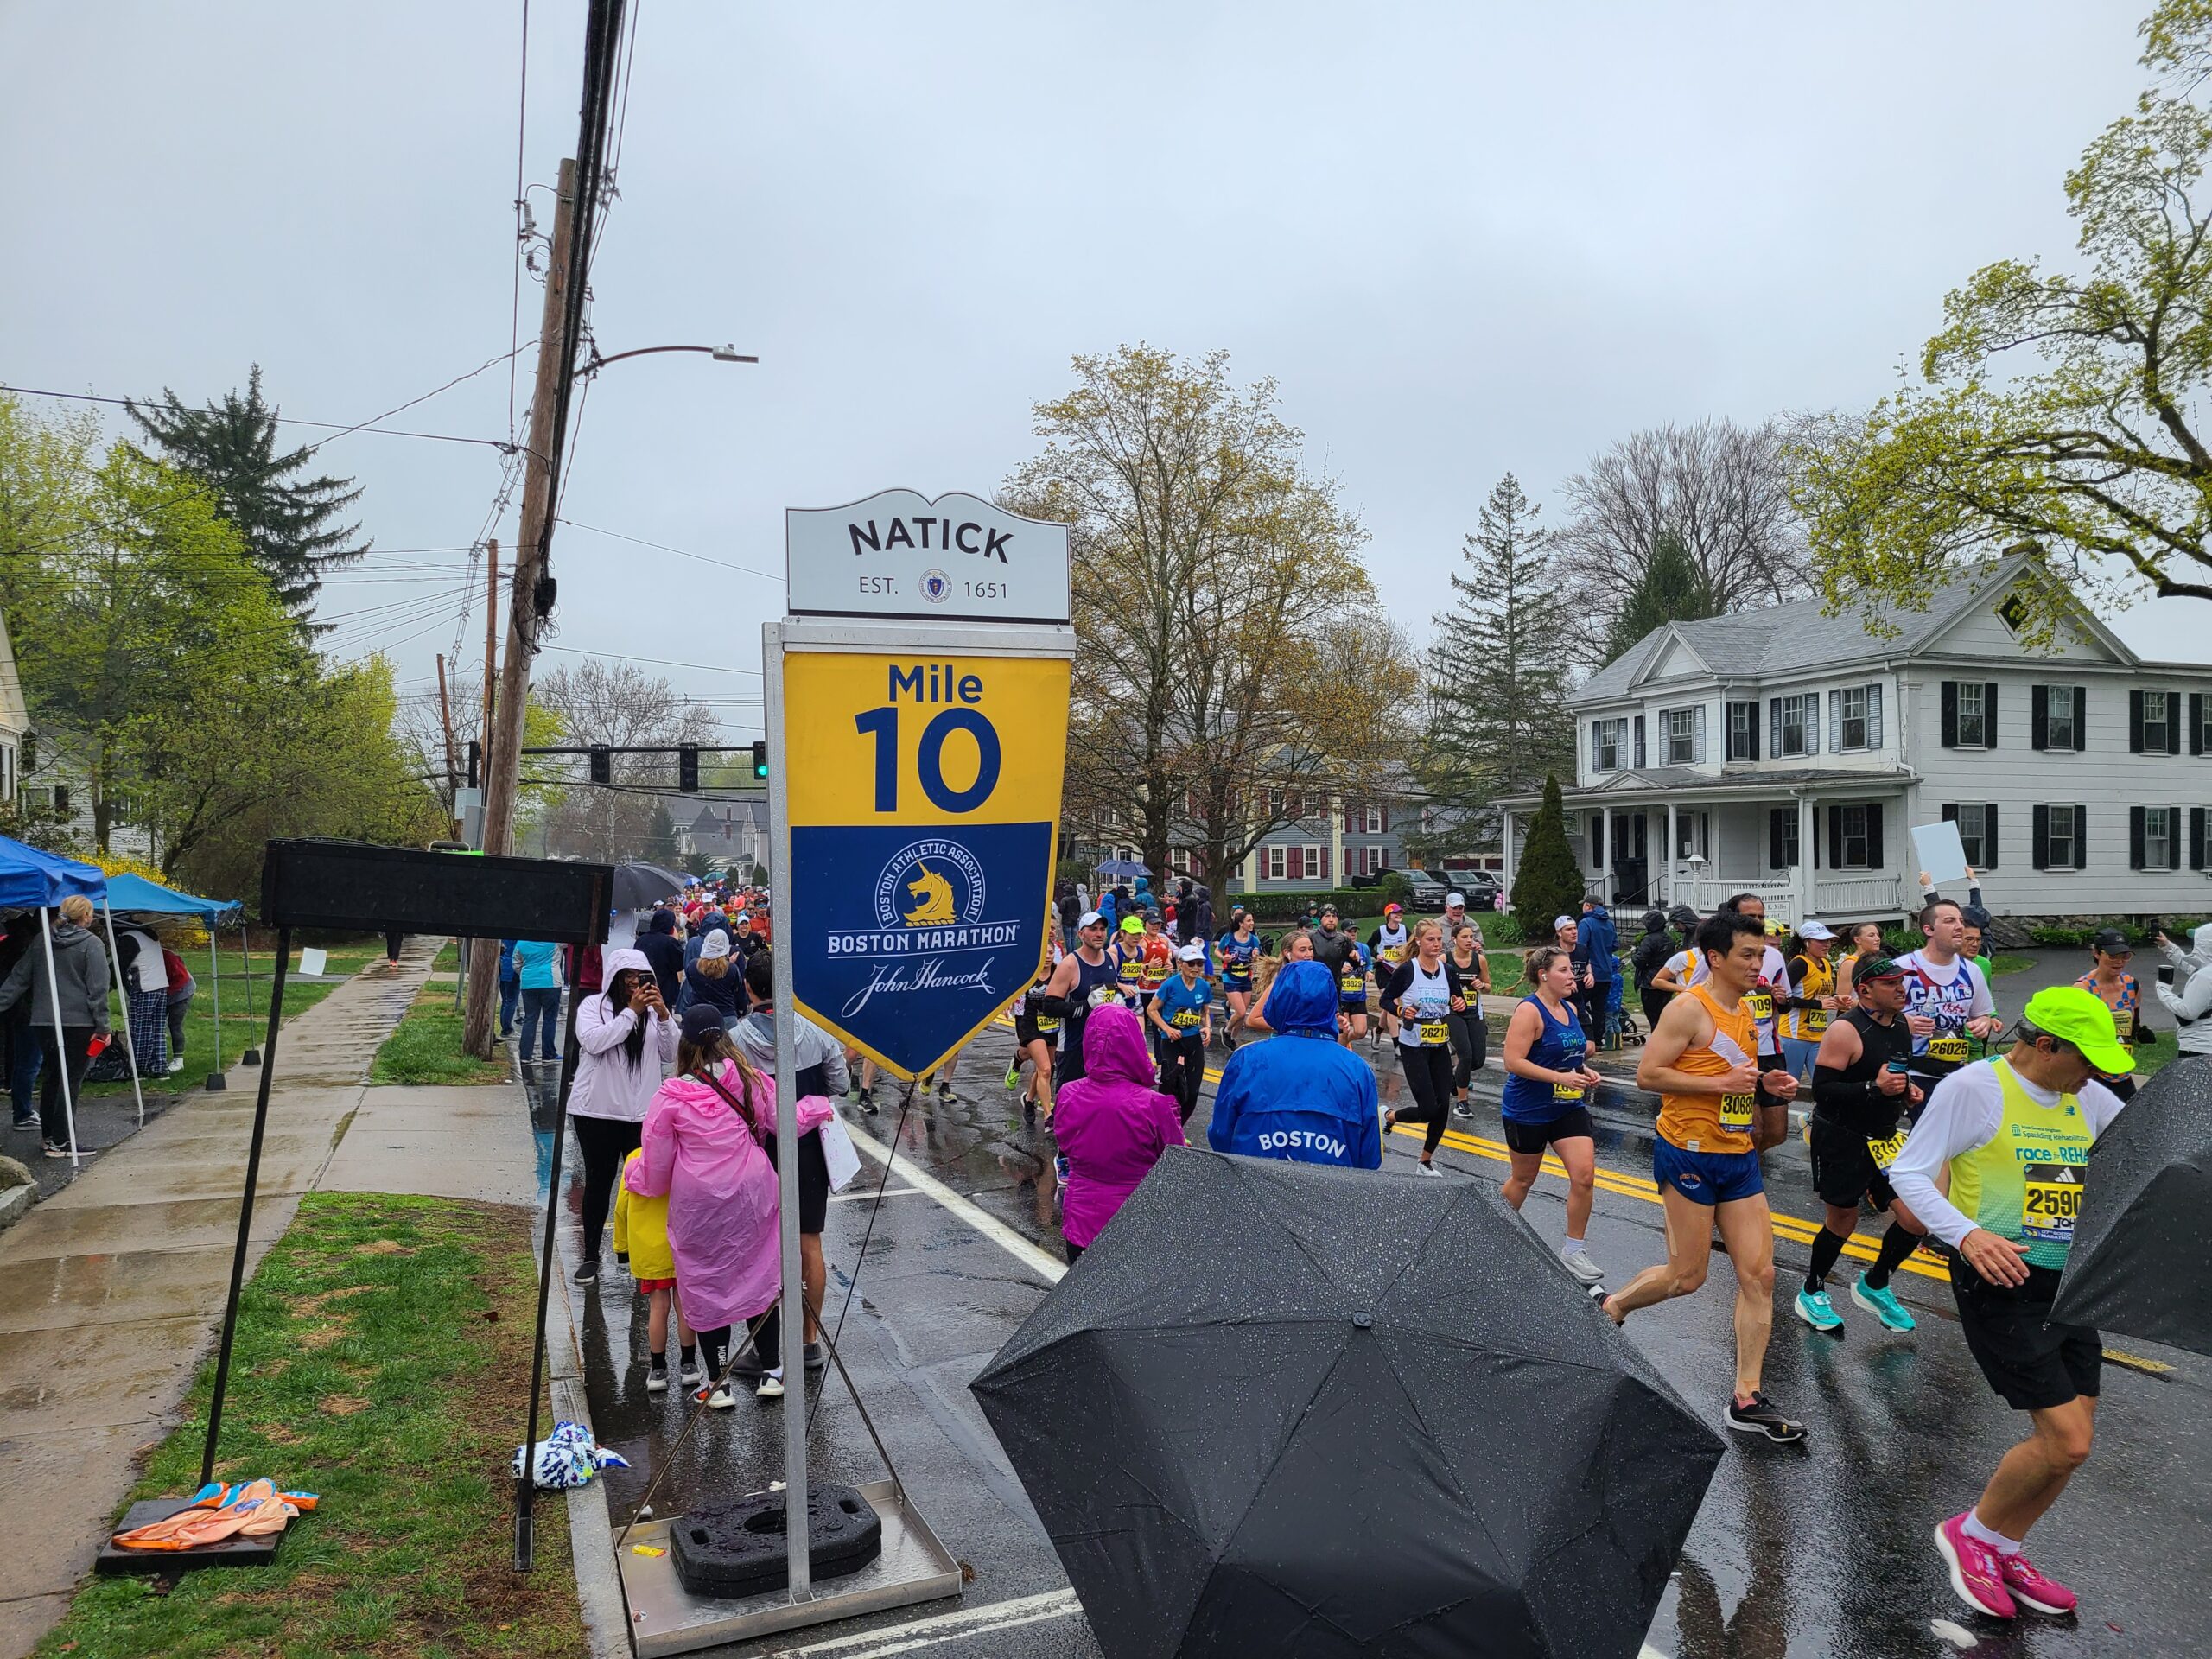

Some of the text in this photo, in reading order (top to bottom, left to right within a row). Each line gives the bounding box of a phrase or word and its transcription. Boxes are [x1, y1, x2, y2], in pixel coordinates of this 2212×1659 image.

[849, 518, 1014, 564] NATICK
[859, 576, 899, 594] EST.
[964, 582, 1007, 599] 1651
[888, 664, 983, 704] Mile
[854, 707, 1001, 814] 10
[880, 842, 982, 922] BOSTON ATHLETIC ASSOCIATION
[828, 925, 1017, 953] BOSTON MARATHON
[841, 957, 996, 1018] John Hancock
[1929, 1042, 1968, 1055] 26025
[1258, 1130, 1347, 1159] BOSTON
[2023, 1130, 2052, 1141] Spaulding
[2016, 1147, 2053, 1161] race
[717, 1345, 727, 1366] MORE
